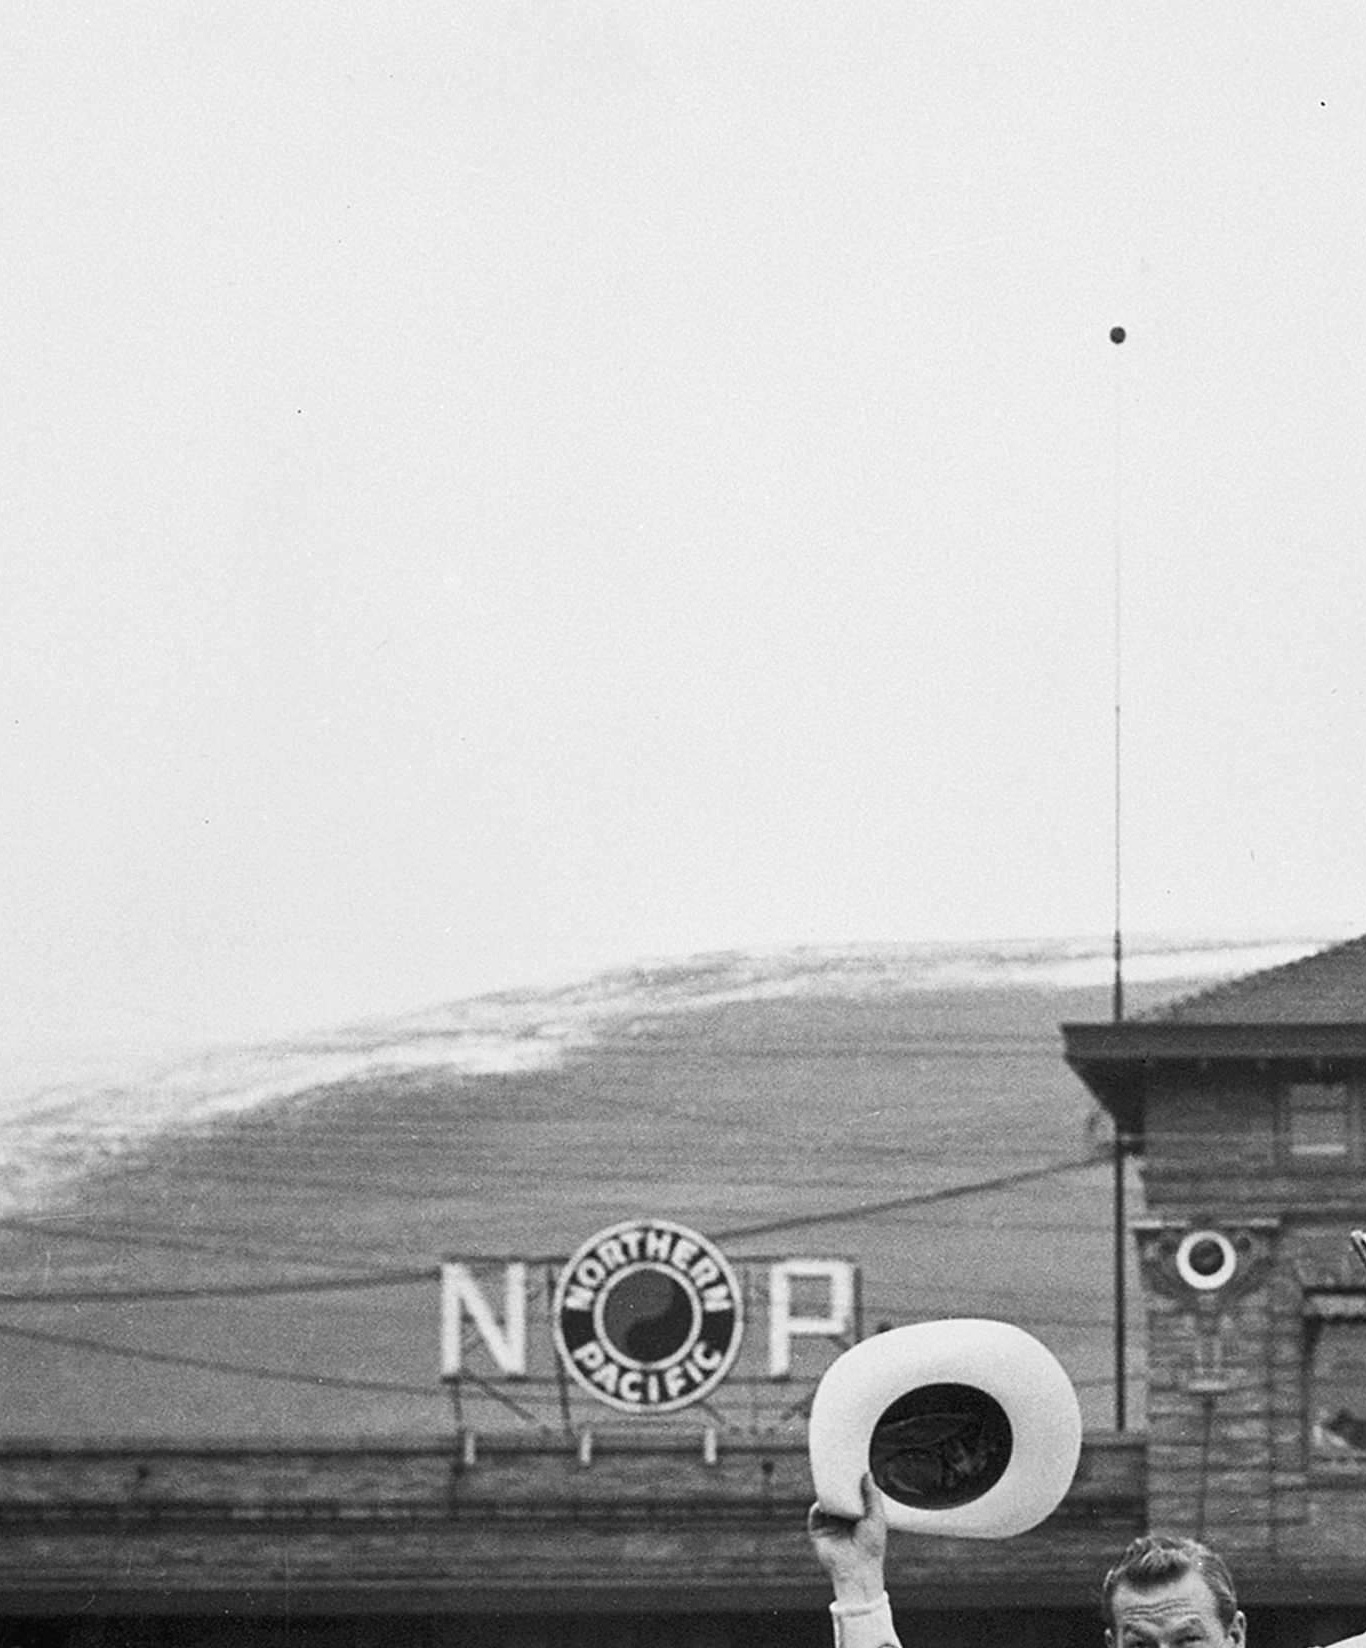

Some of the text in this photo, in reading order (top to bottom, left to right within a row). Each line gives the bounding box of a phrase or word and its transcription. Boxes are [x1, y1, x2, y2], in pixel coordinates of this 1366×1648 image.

[564, 1229, 732, 1313] NORTHERN
[440, 1258, 856, 1377] N P
[572, 1339, 724, 1403] PACIFIC
